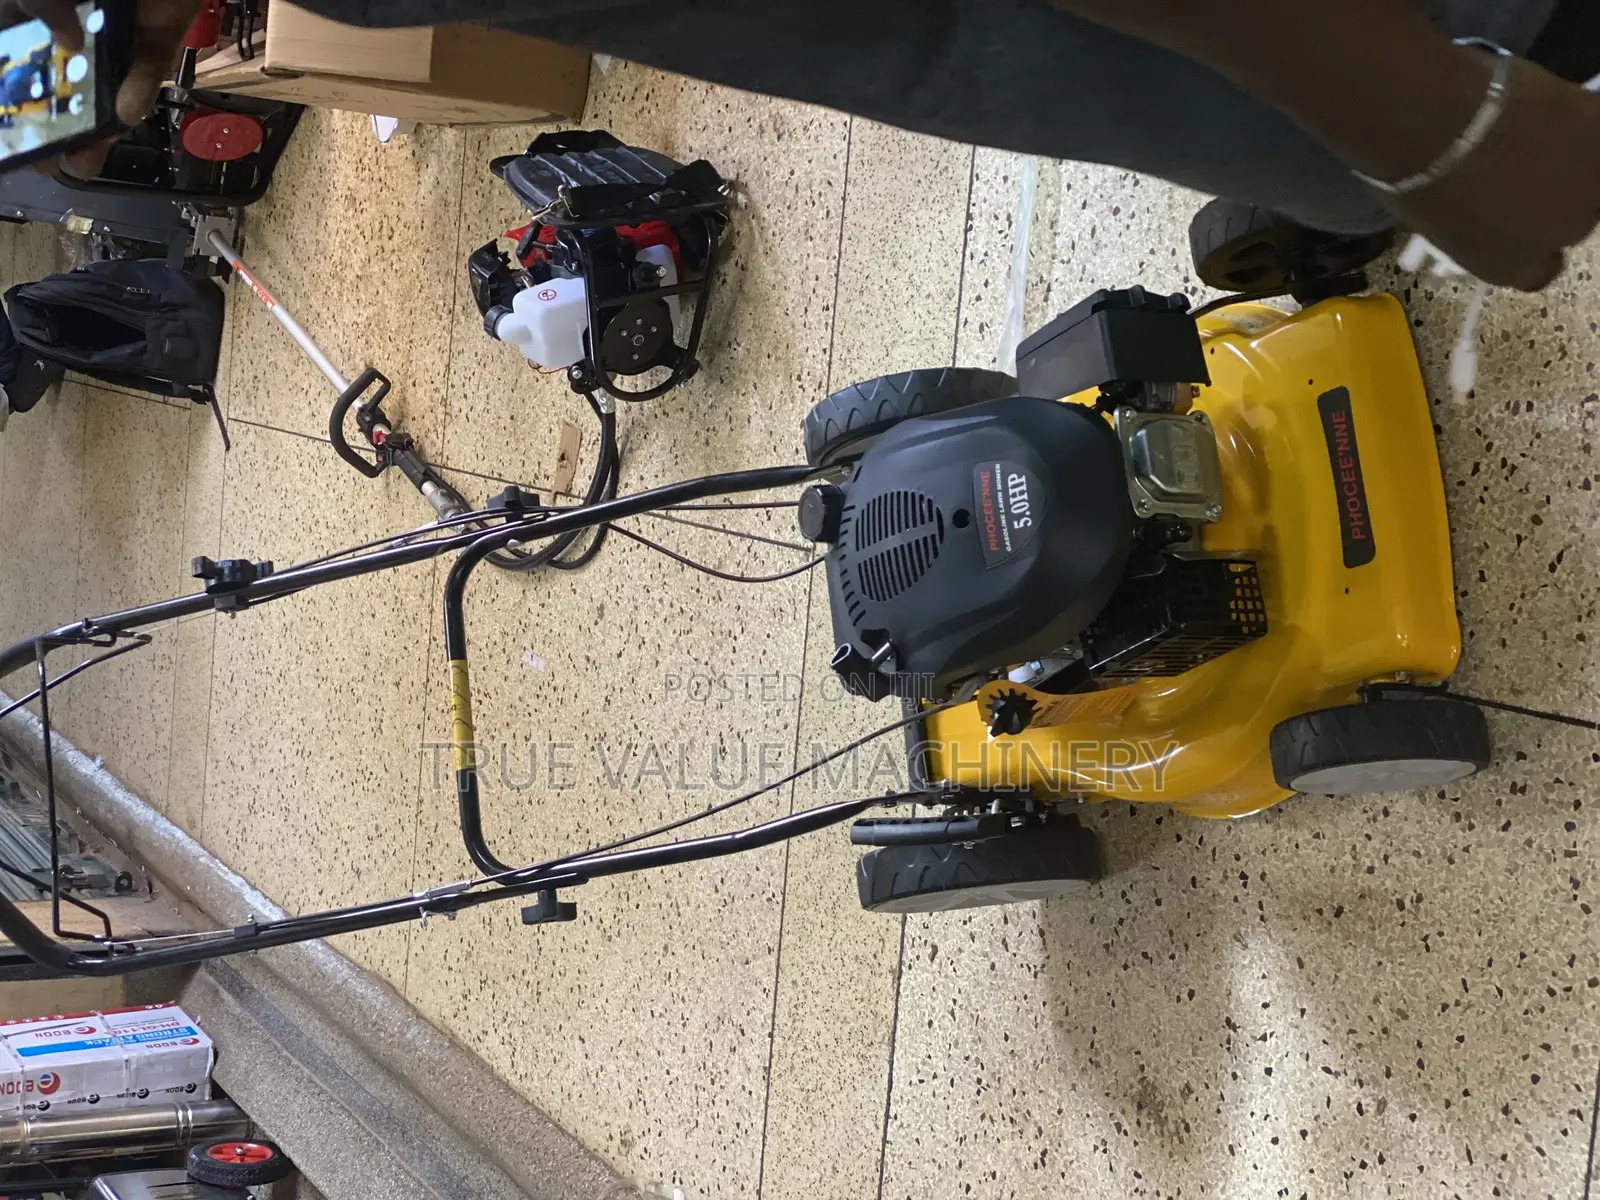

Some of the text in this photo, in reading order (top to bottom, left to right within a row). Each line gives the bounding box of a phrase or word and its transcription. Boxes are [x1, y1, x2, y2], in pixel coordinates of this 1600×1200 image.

[1332, 409, 1367, 540] PHOCEE'NNE
[980, 471, 1000, 551] PHOCEE'NNE
[997, 491, 1006, 513] LAWN
[1007, 472, 1033, 530] 5.0HP
[1000, 514, 1012, 552] GASOLINE
[84, 1034, 134, 1045] ATACK
